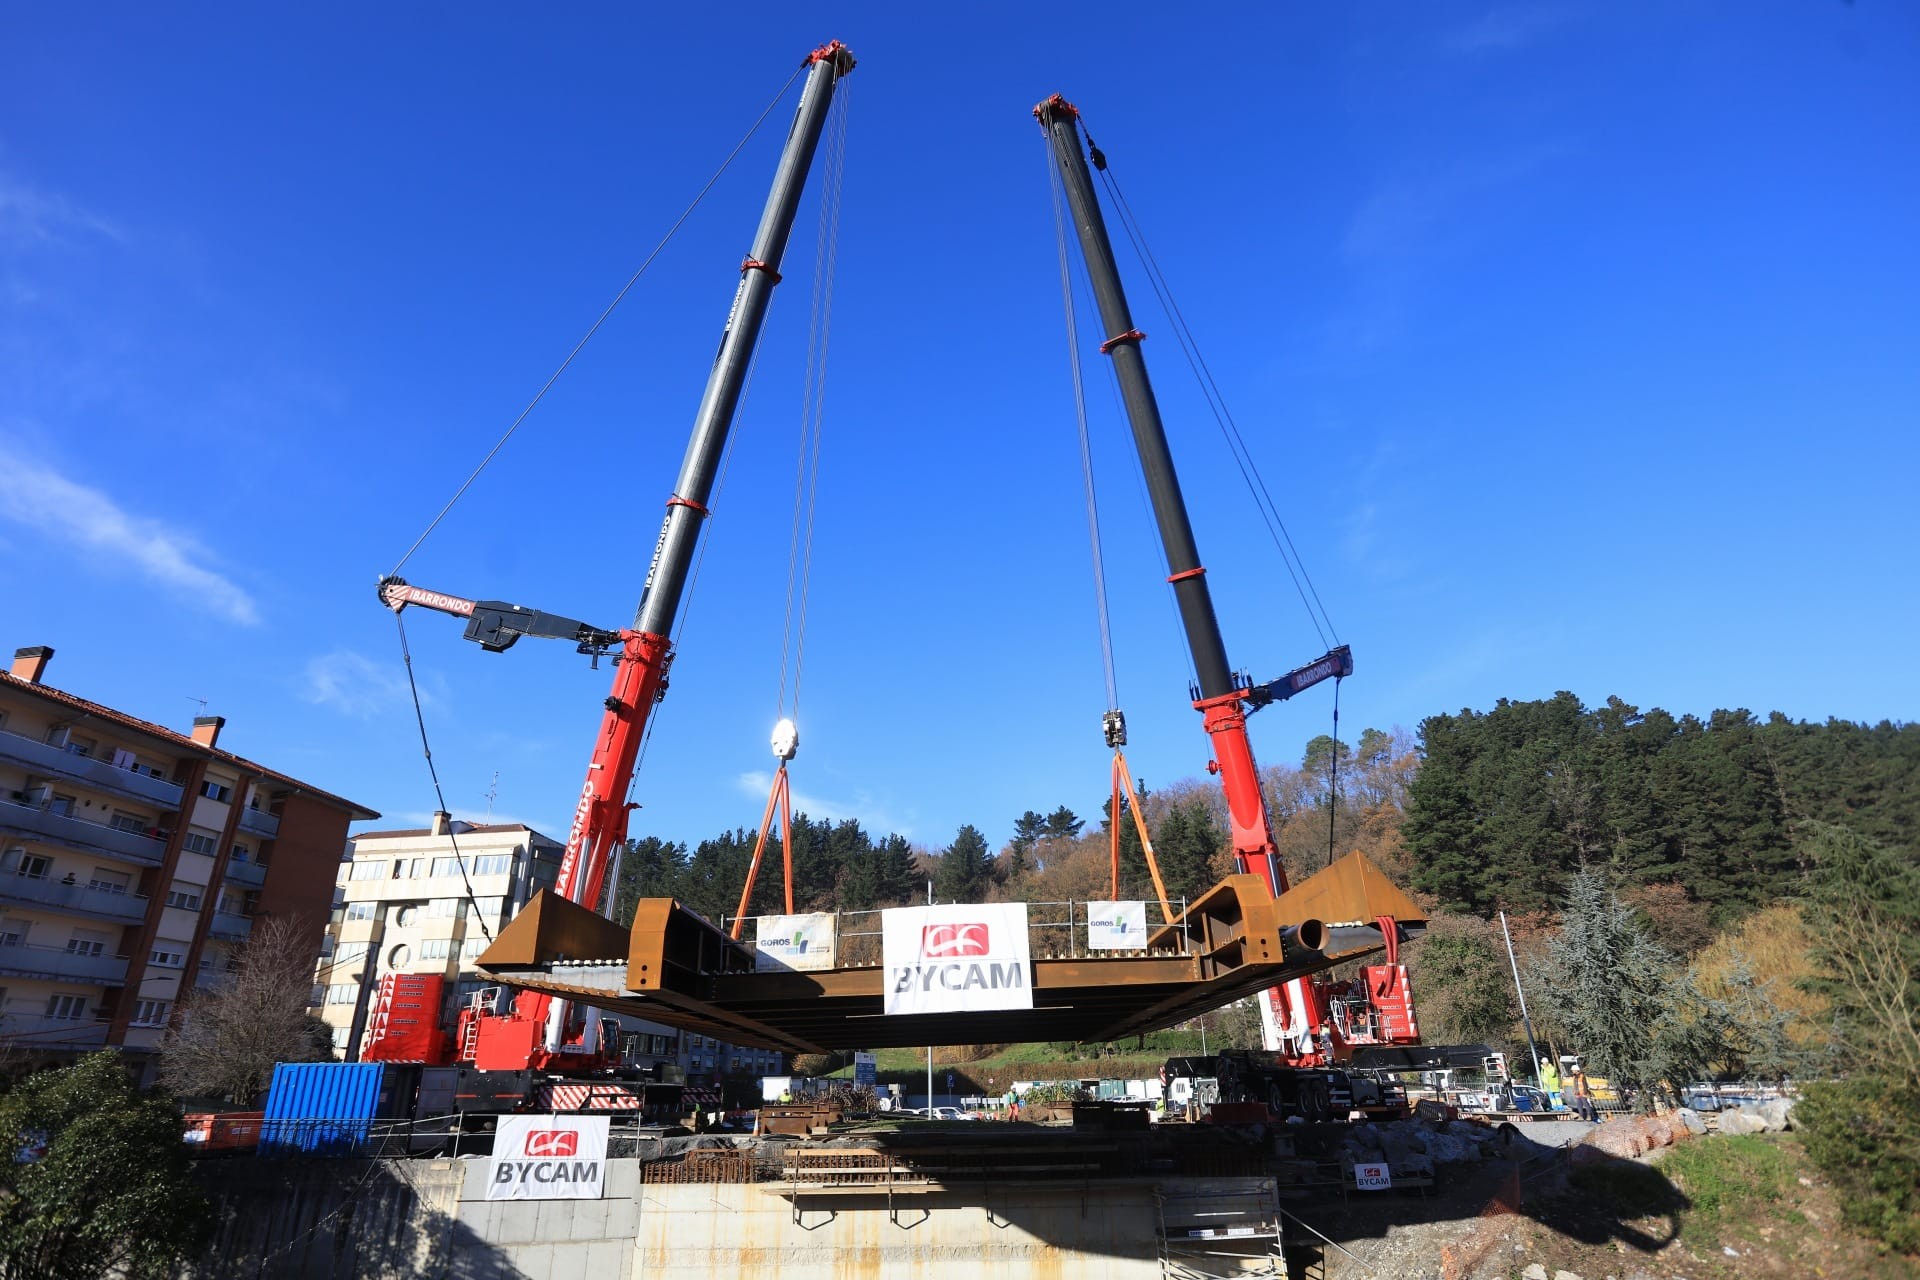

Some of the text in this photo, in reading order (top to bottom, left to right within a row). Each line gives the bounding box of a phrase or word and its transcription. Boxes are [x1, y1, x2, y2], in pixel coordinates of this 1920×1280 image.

[409, 590, 471, 612] IBARRONDO
[554, 780, 594, 897] BARRONDO
[760, 938, 791, 946] GOROS
[893, 962, 1022, 993] BYCAM
[495, 1161, 598, 1184] BYCAM
